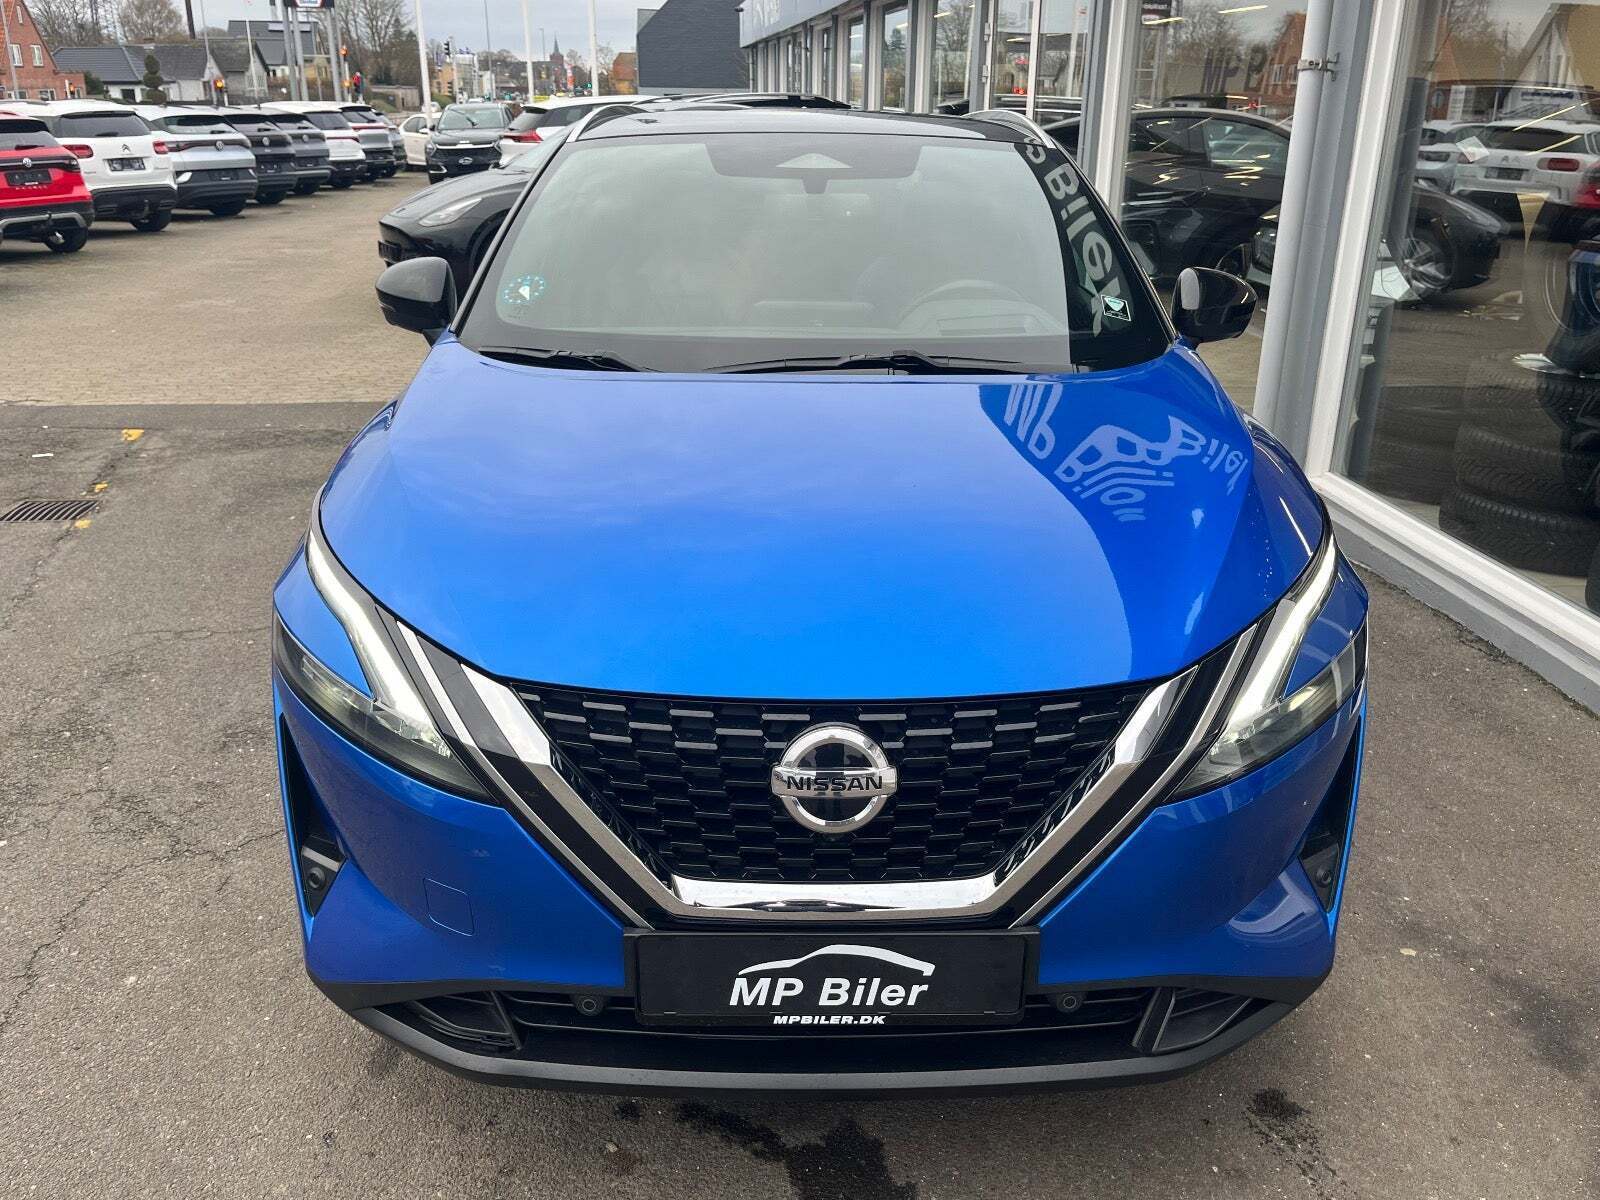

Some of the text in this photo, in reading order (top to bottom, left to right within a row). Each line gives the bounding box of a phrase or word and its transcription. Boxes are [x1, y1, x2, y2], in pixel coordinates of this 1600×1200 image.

[786, 775, 883, 792] NISSAN
[729, 977, 928, 1006] MP Biler
[773, 1015, 886, 1025] MPBILER.DK
